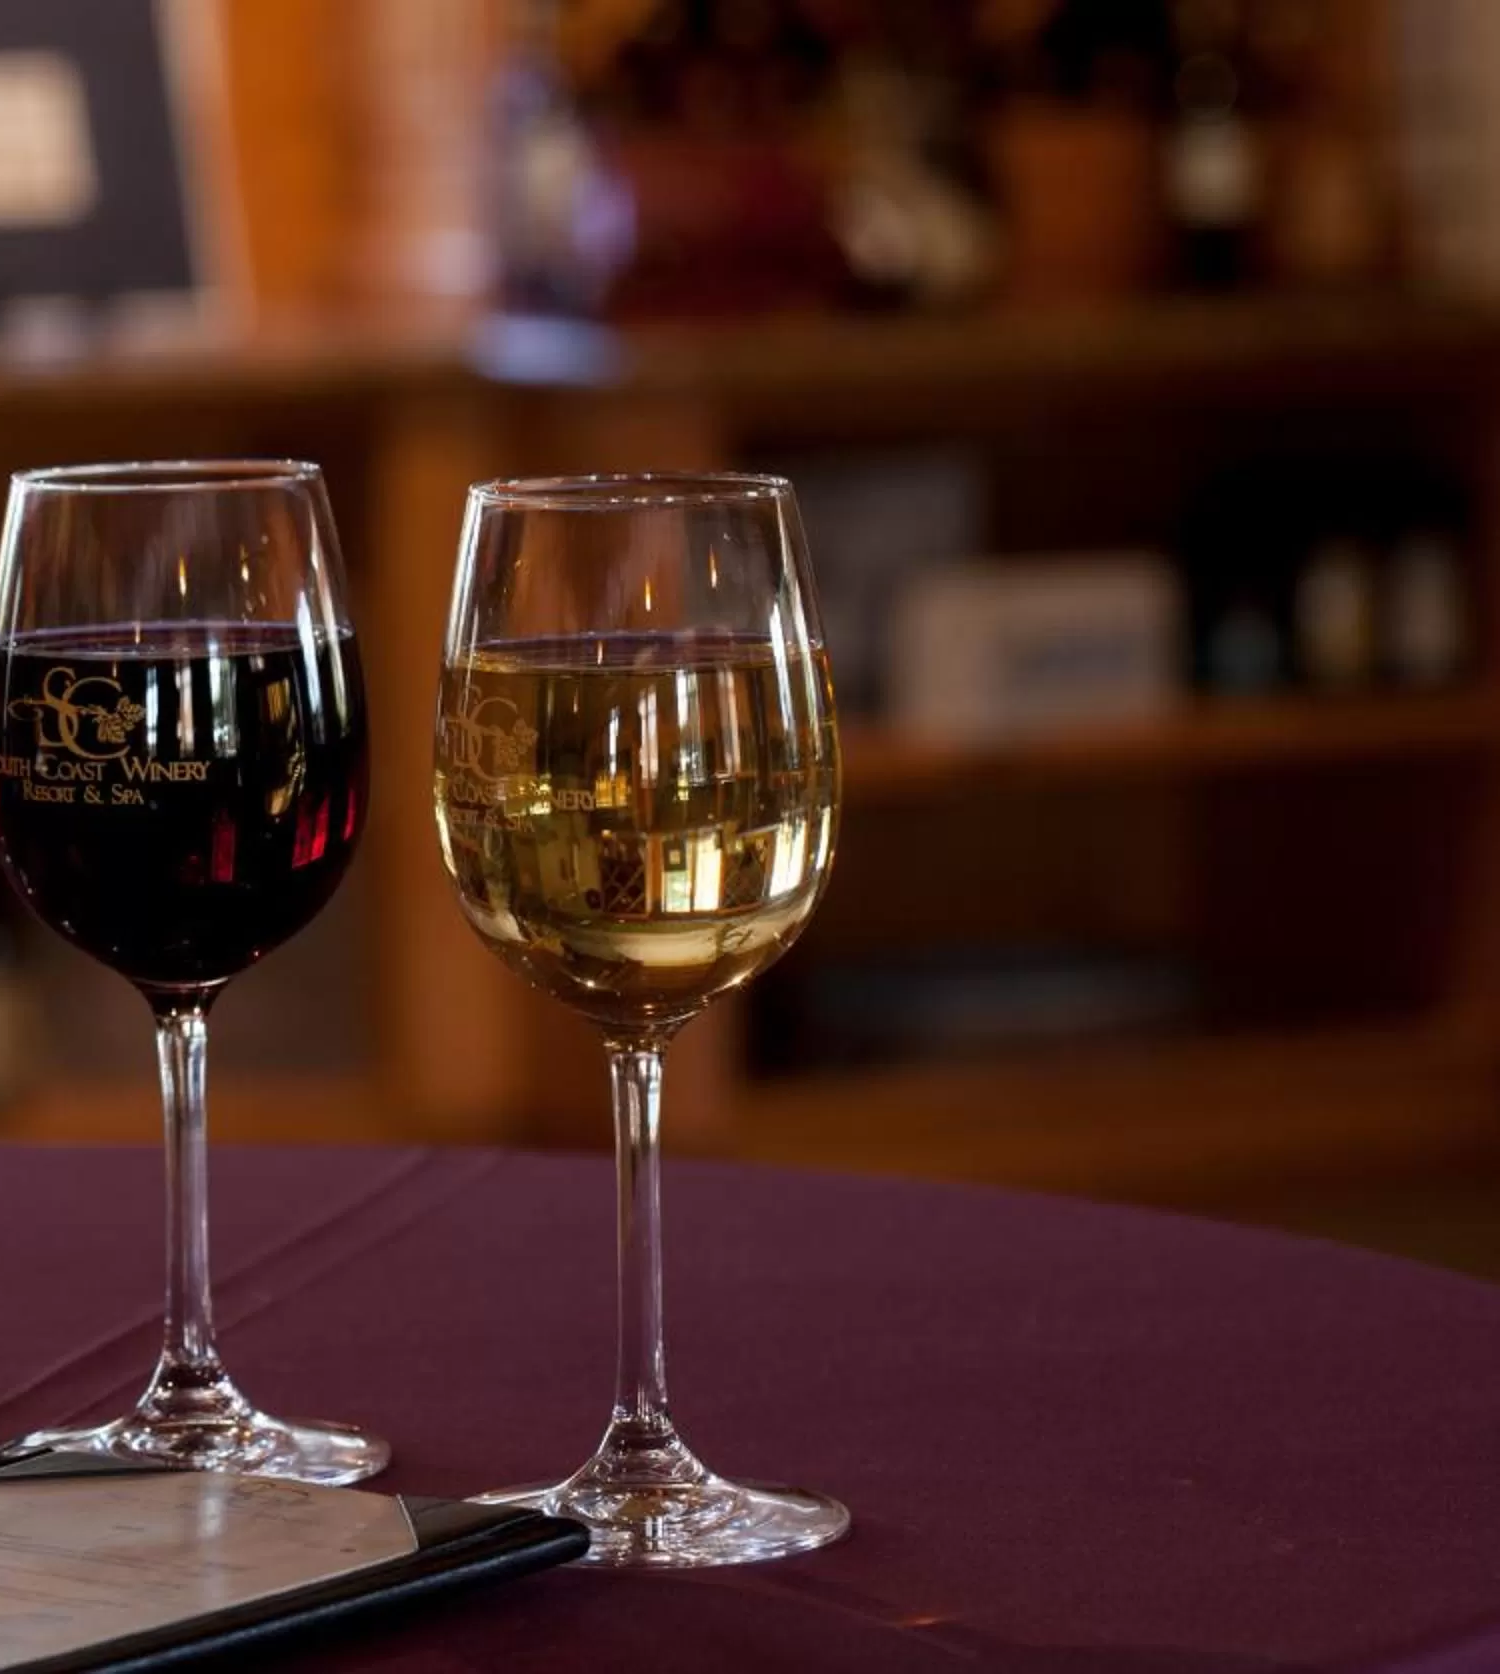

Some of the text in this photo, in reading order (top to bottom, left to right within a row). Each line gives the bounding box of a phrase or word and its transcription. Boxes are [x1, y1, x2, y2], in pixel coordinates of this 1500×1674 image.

[41, 753, 107, 782] COAST
[119, 755, 211, 783] WINERY
[22, 779, 145, 805] RESORT & SPA
